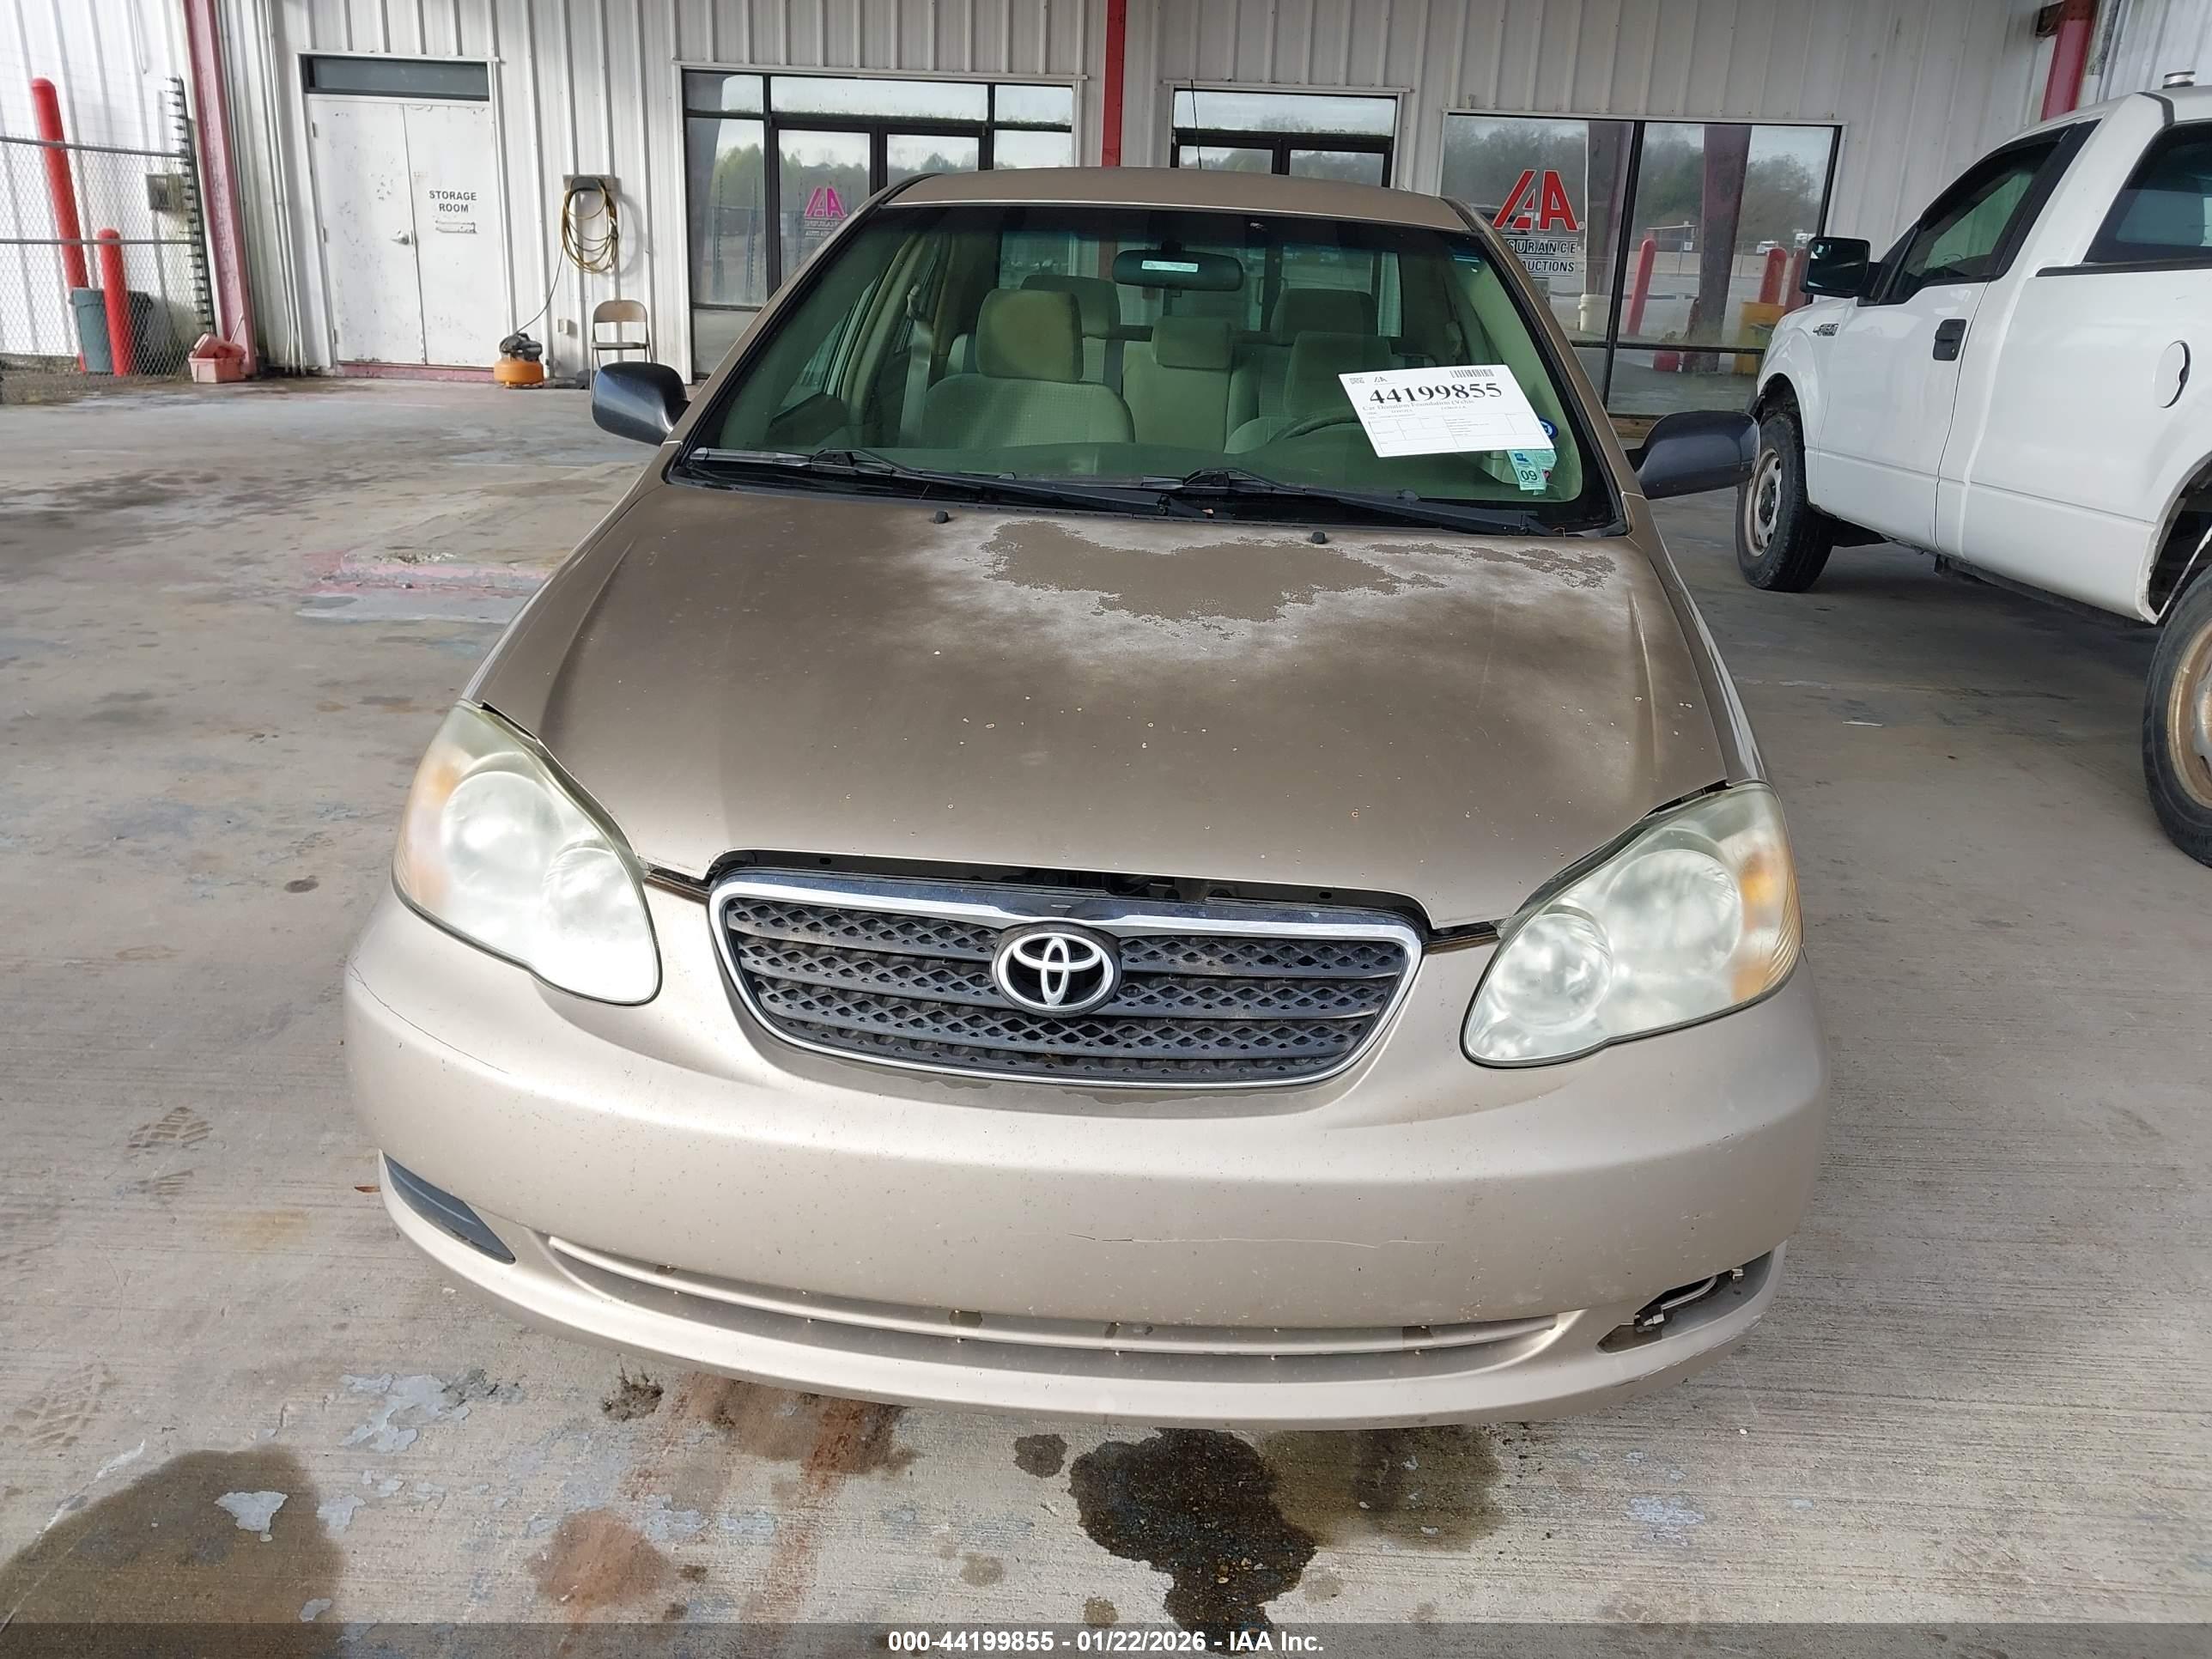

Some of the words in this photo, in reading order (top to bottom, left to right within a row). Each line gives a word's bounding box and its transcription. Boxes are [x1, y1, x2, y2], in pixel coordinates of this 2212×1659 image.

[428, 190, 477, 201] STORAGE
[439, 203, 469, 213] ROOM
[1370, 382, 1502, 404] 44199855
[1521, 470, 1538, 482] 09
